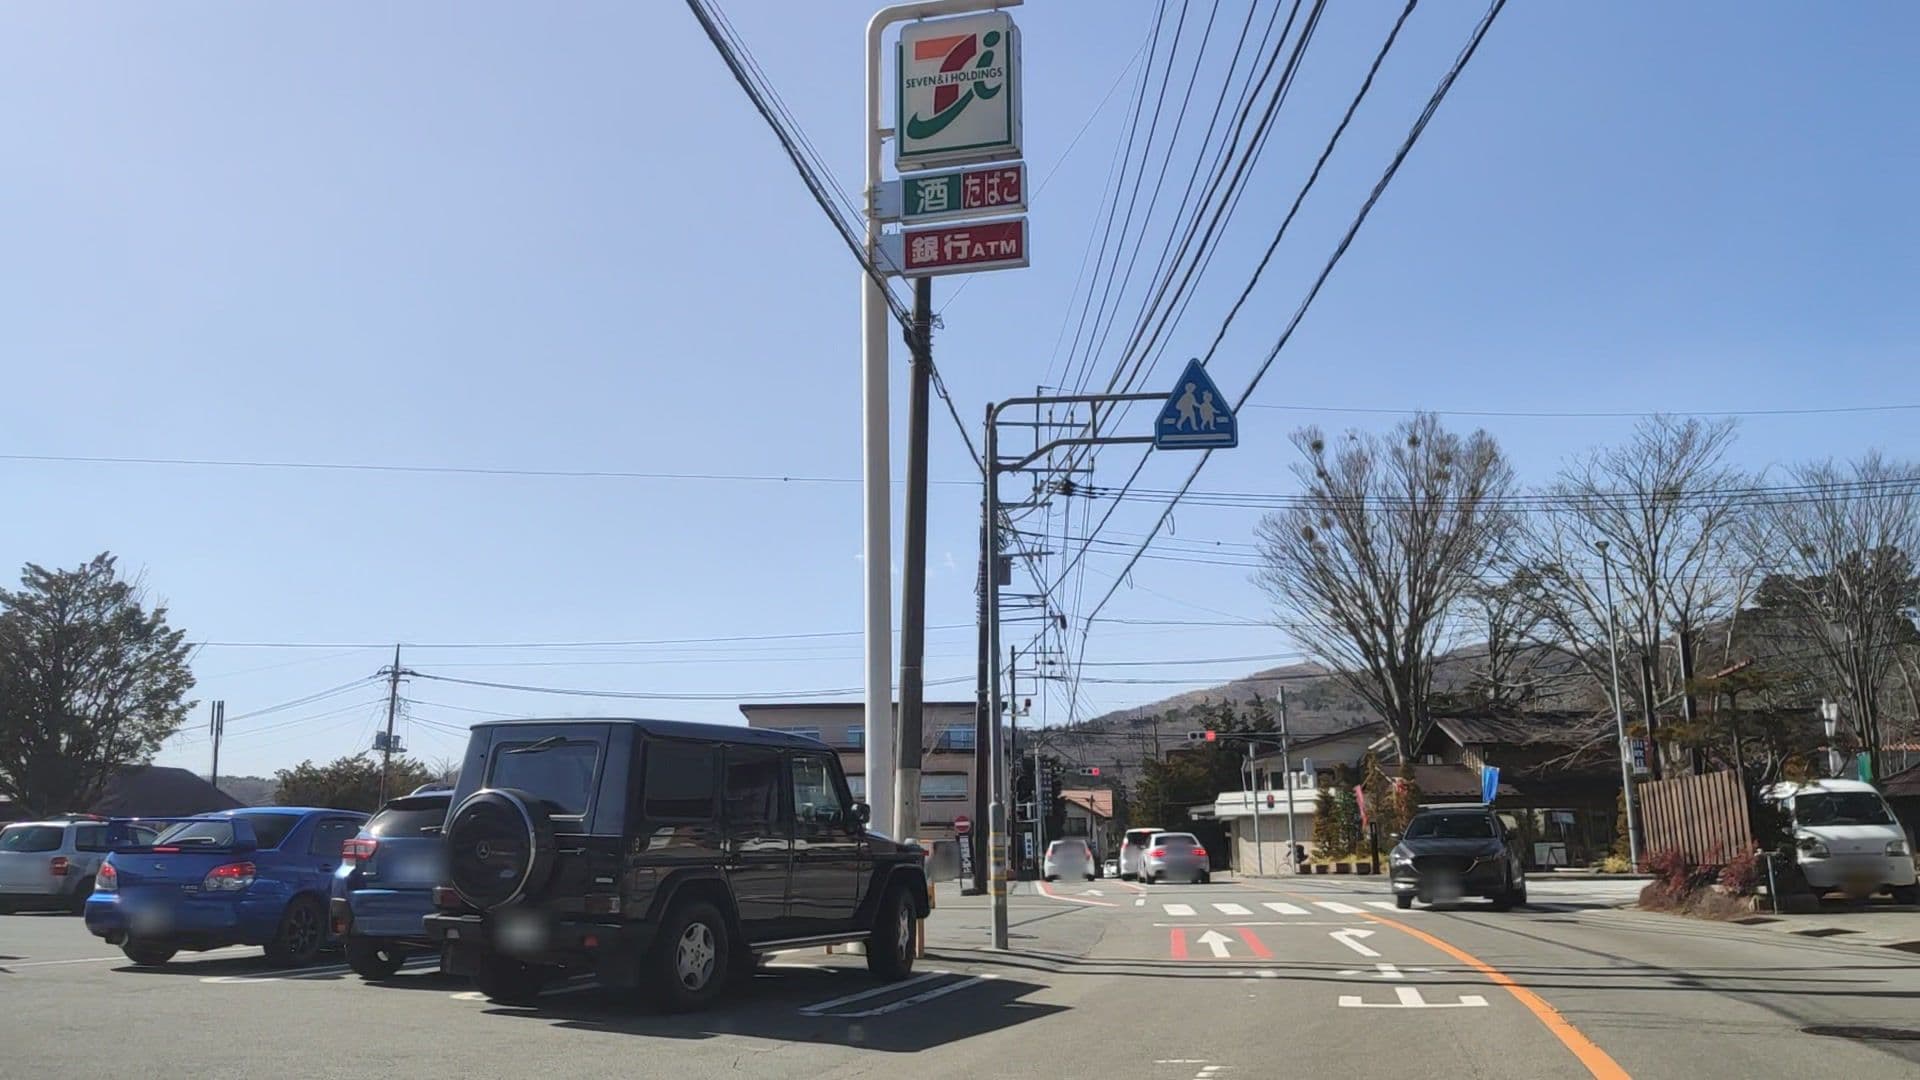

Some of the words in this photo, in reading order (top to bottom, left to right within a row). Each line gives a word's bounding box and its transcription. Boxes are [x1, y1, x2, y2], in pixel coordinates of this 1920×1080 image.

[951, 66, 1003, 83] HOLDINGS
[916, 177, 949, 213] 酒
[965, 171, 1019, 208] たばこ
